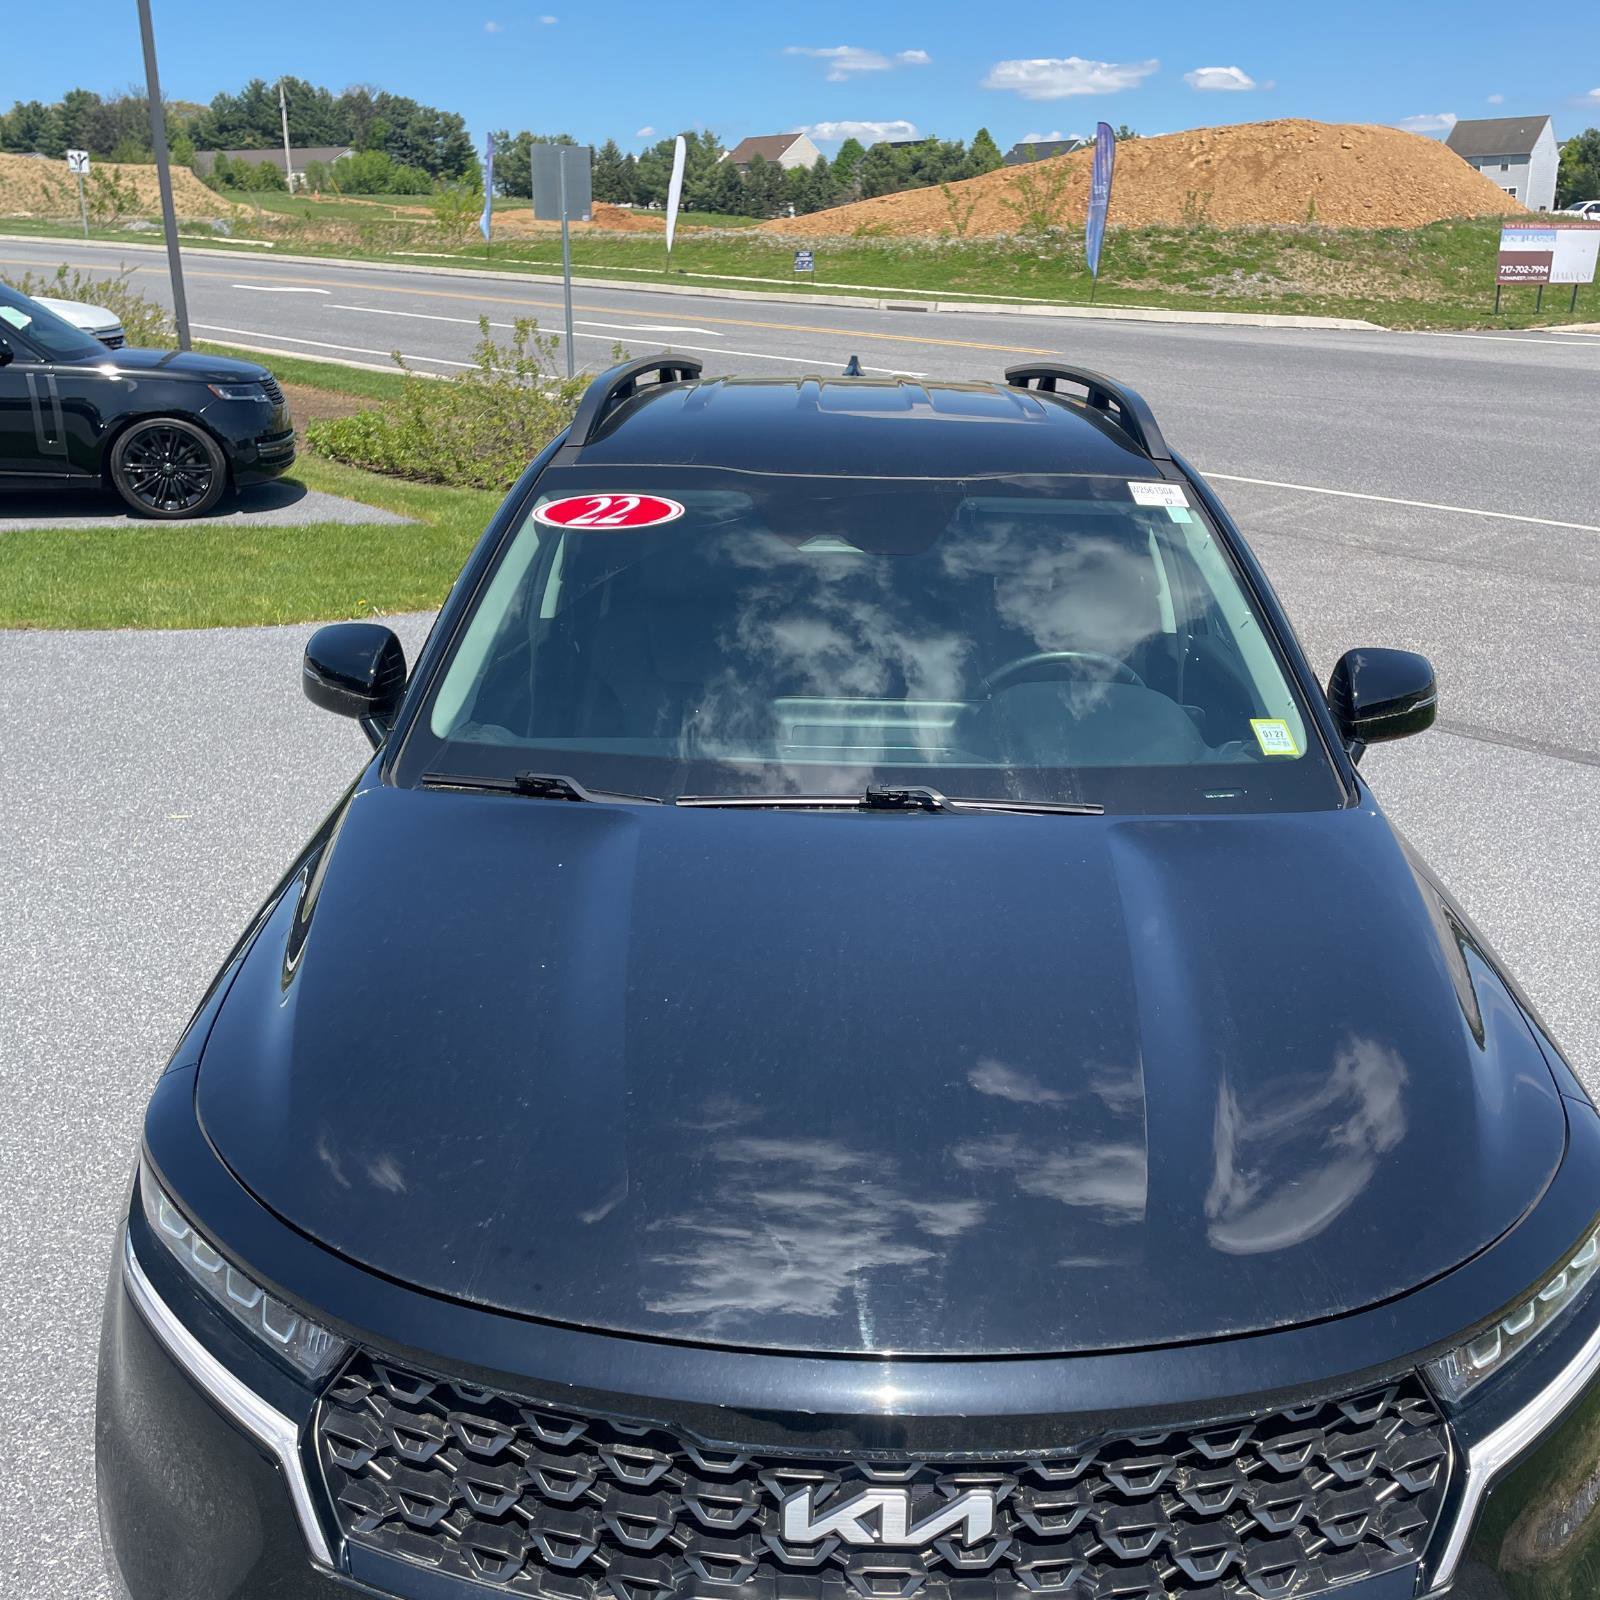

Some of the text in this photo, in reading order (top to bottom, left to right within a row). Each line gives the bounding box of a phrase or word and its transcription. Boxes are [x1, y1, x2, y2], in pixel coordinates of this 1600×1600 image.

[1500, 265, 1548, 273] 717-702-7994
[564, 497, 640, 525] 22
[784, 1486, 994, 1546] KIA
